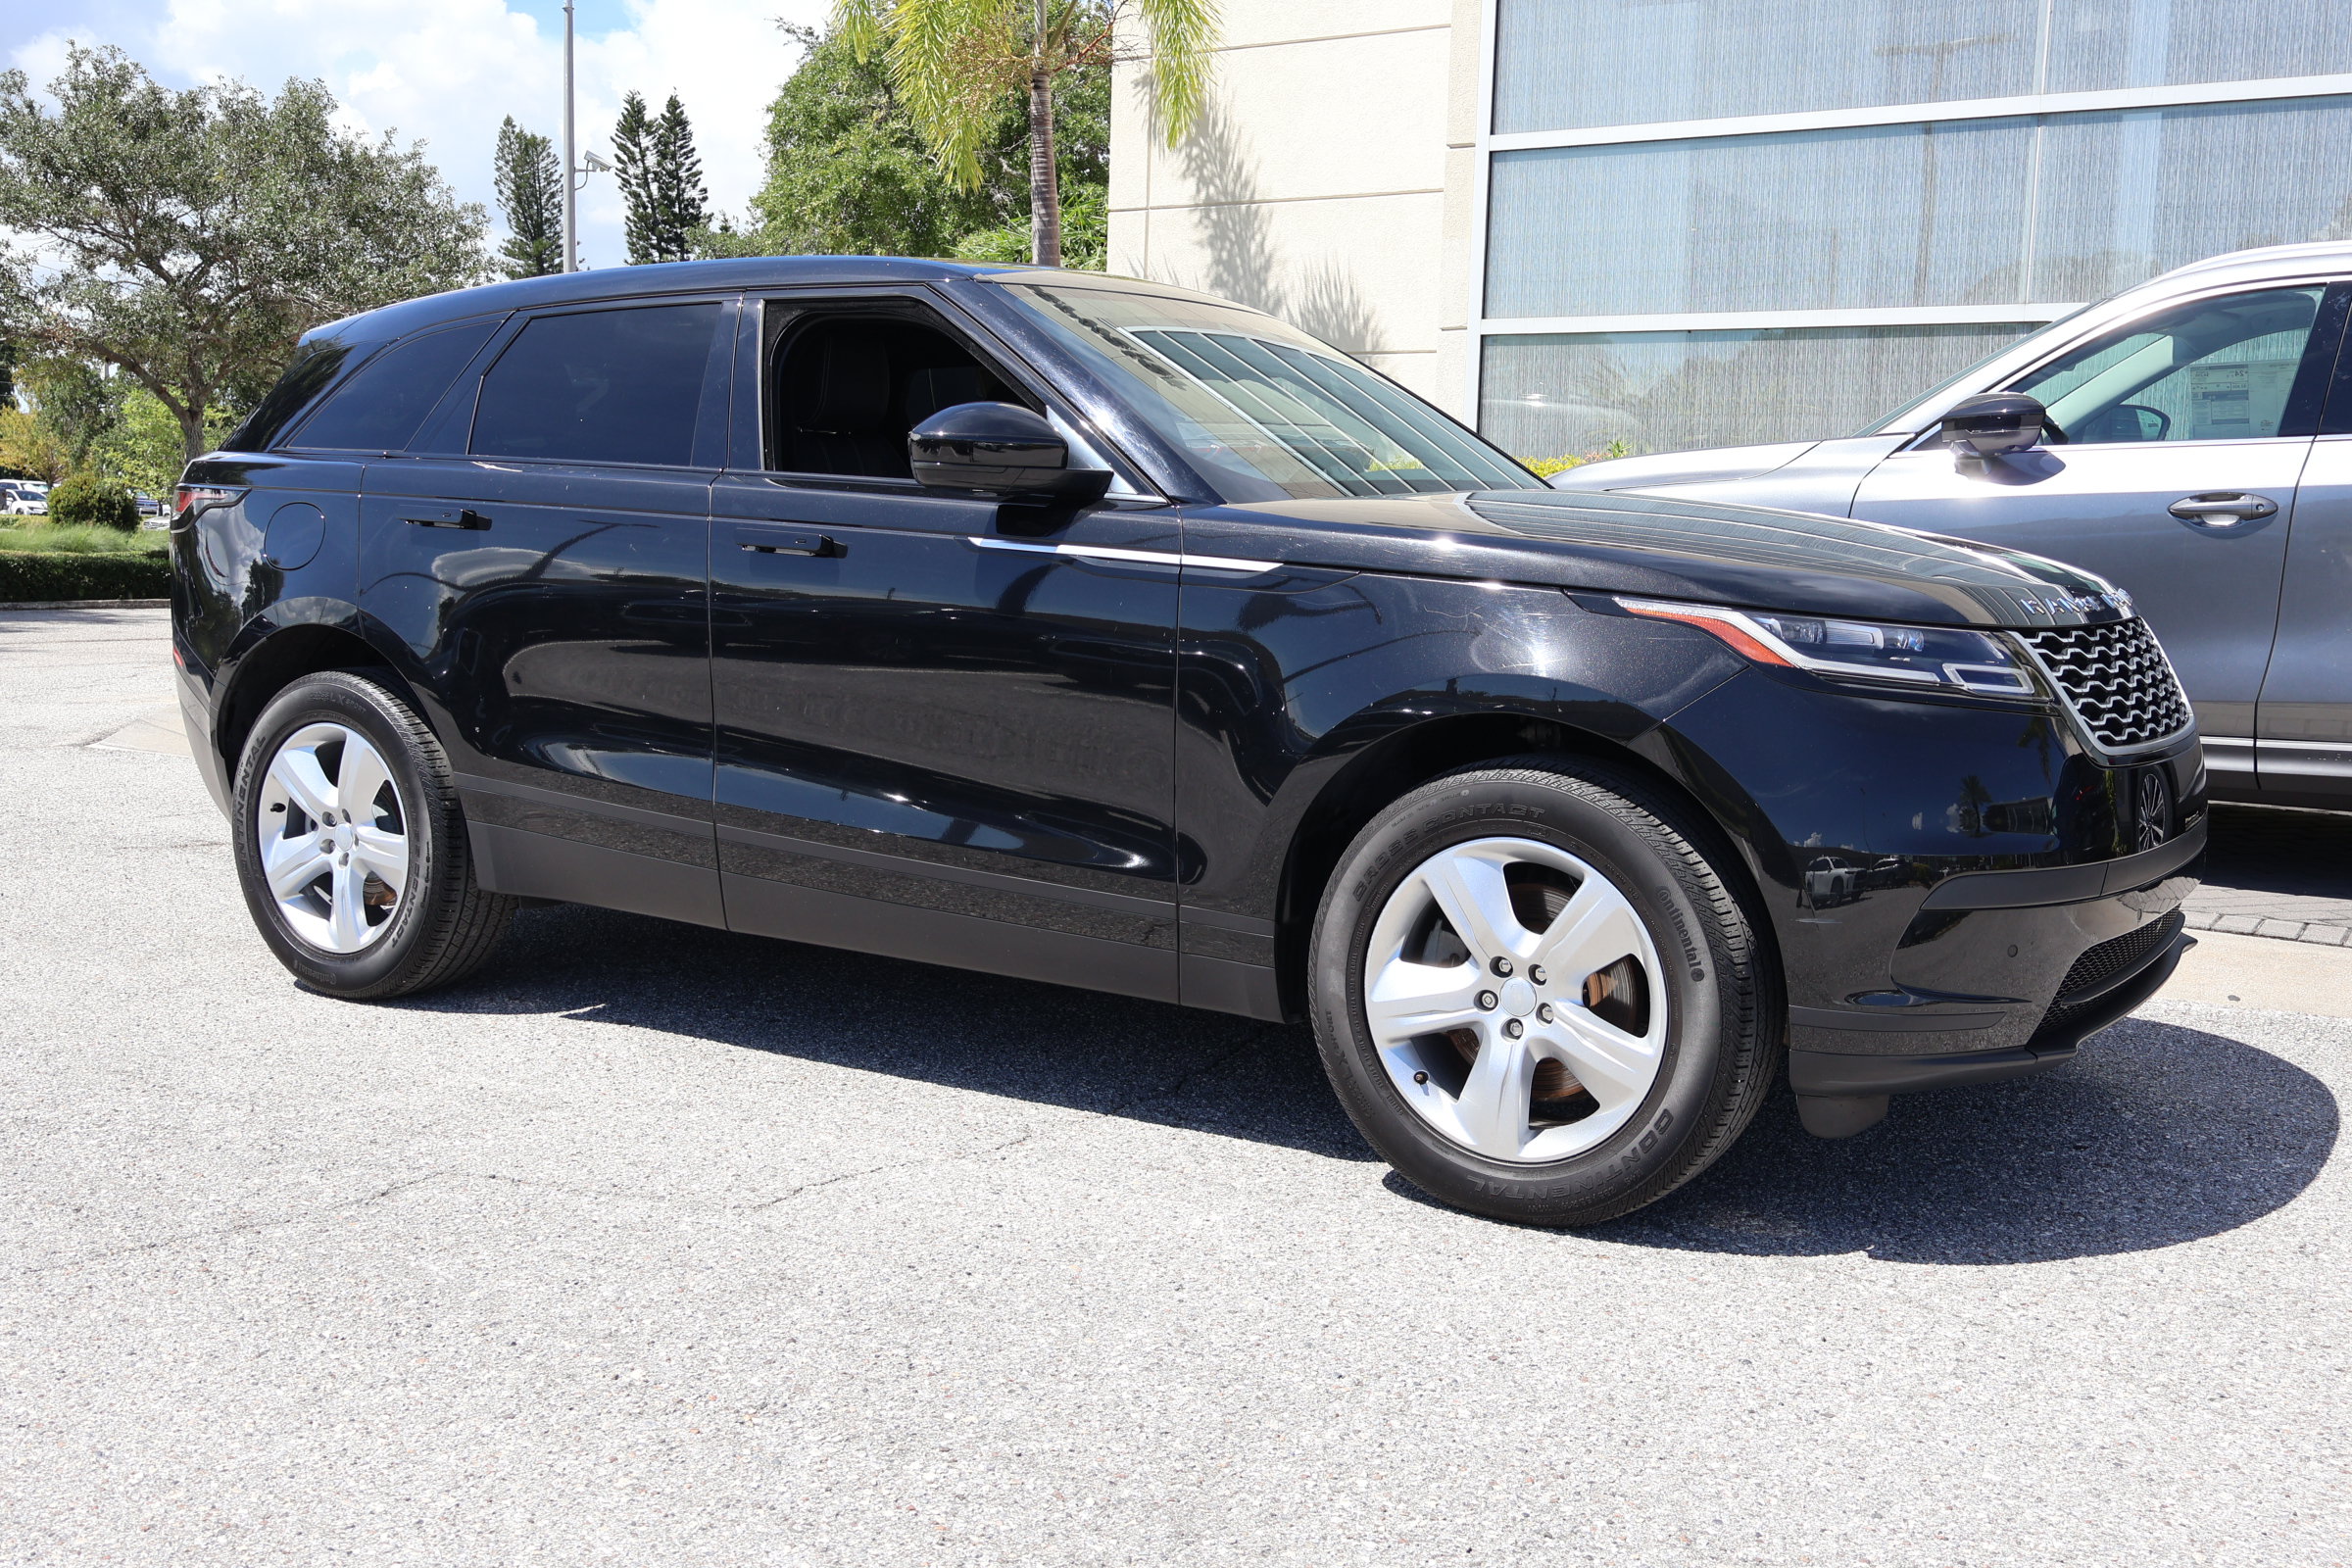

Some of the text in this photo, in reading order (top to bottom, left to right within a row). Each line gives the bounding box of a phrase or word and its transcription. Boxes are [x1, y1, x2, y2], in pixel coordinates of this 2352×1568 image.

[1351, 827, 1419, 903] CROSS
[1422, 803, 1545, 829] CONTACT
[1653, 885, 1702, 969] Continental
[1466, 1107, 1675, 1200] CONTINENTAL
